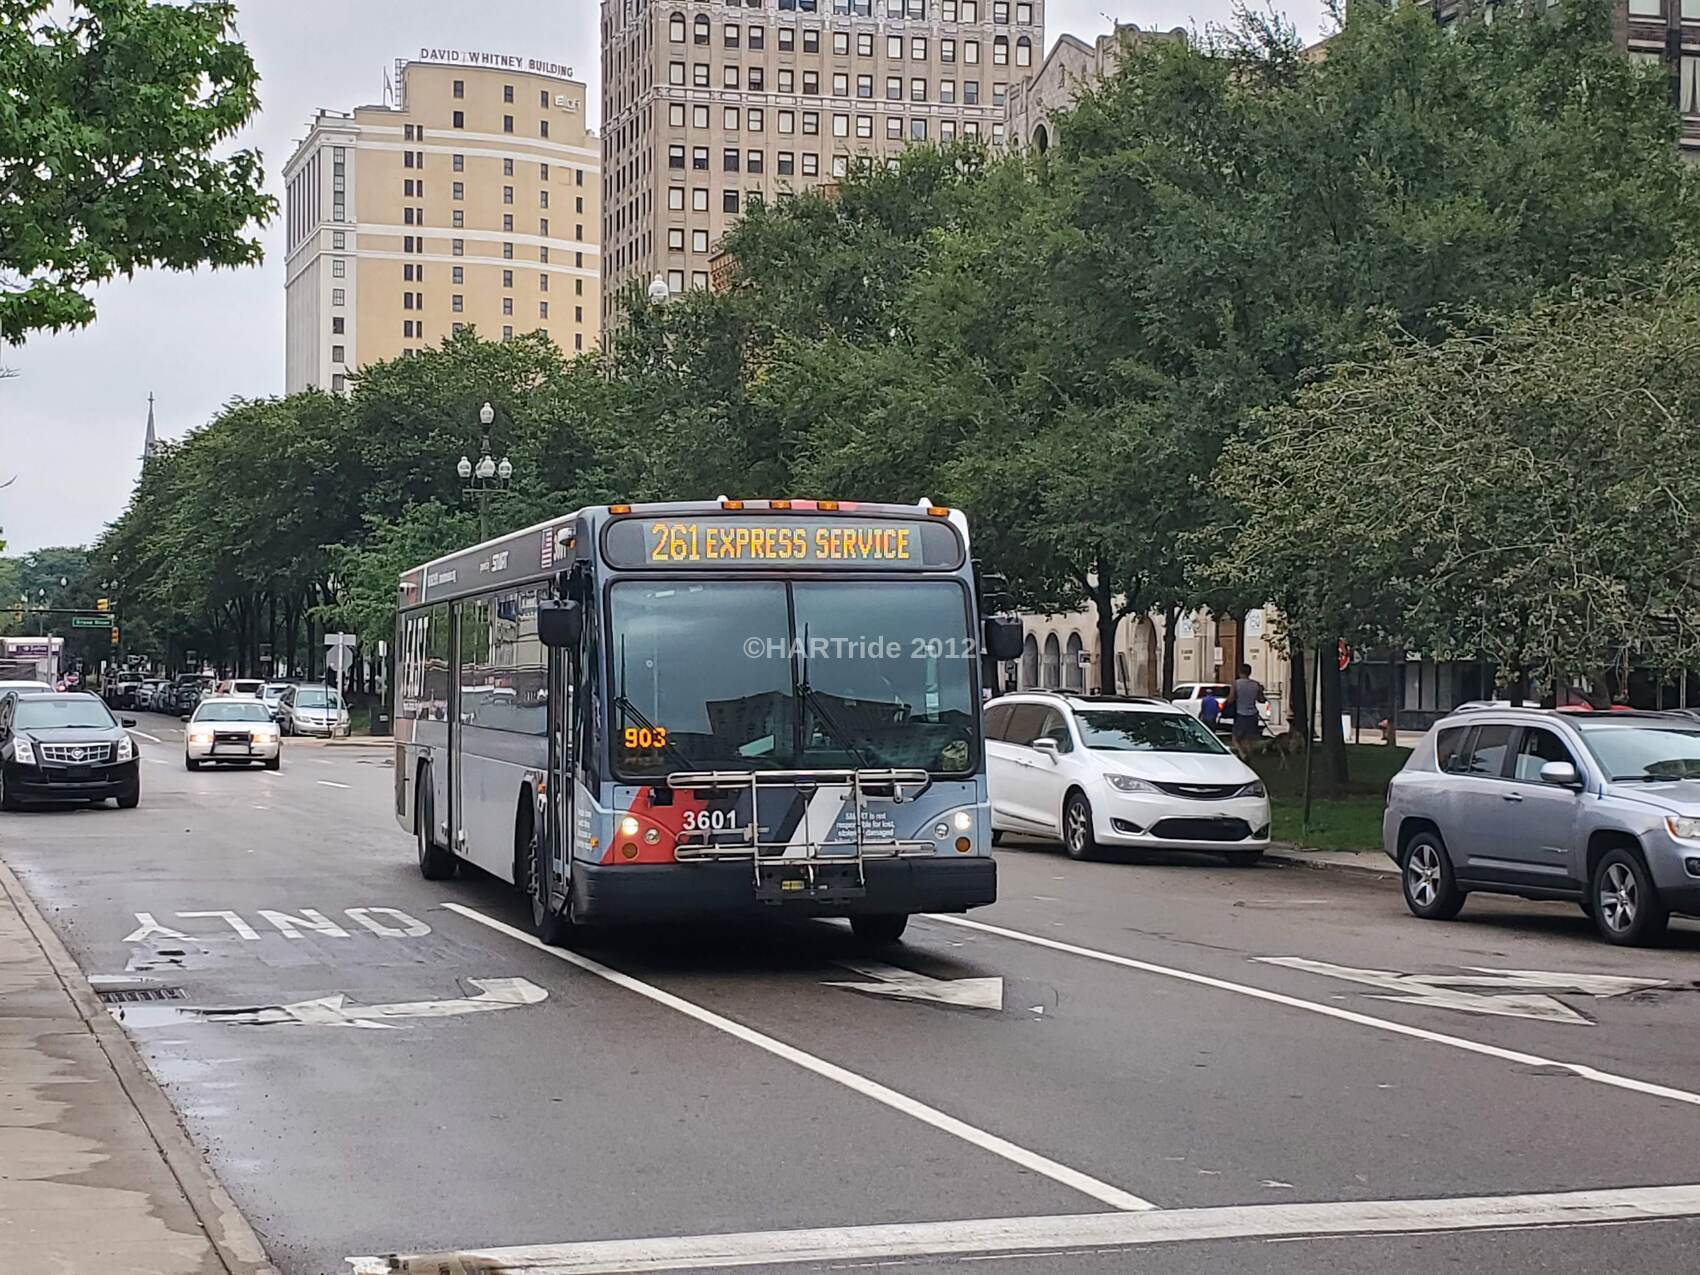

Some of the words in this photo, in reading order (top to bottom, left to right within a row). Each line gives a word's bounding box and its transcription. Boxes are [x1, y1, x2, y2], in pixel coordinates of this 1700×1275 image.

[421, 48, 459, 61] DAVID
[469, 51, 523, 69] WHITNEY
[528, 58, 574, 78] BUILDING
[652, 523, 700, 561] 261
[706, 527, 807, 559] EXPRESS
[815, 528, 910, 559] SERVICE
[624, 727, 667, 748] 903
[682, 809, 736, 830] 3601
[122, 907, 433, 942] ONLY
